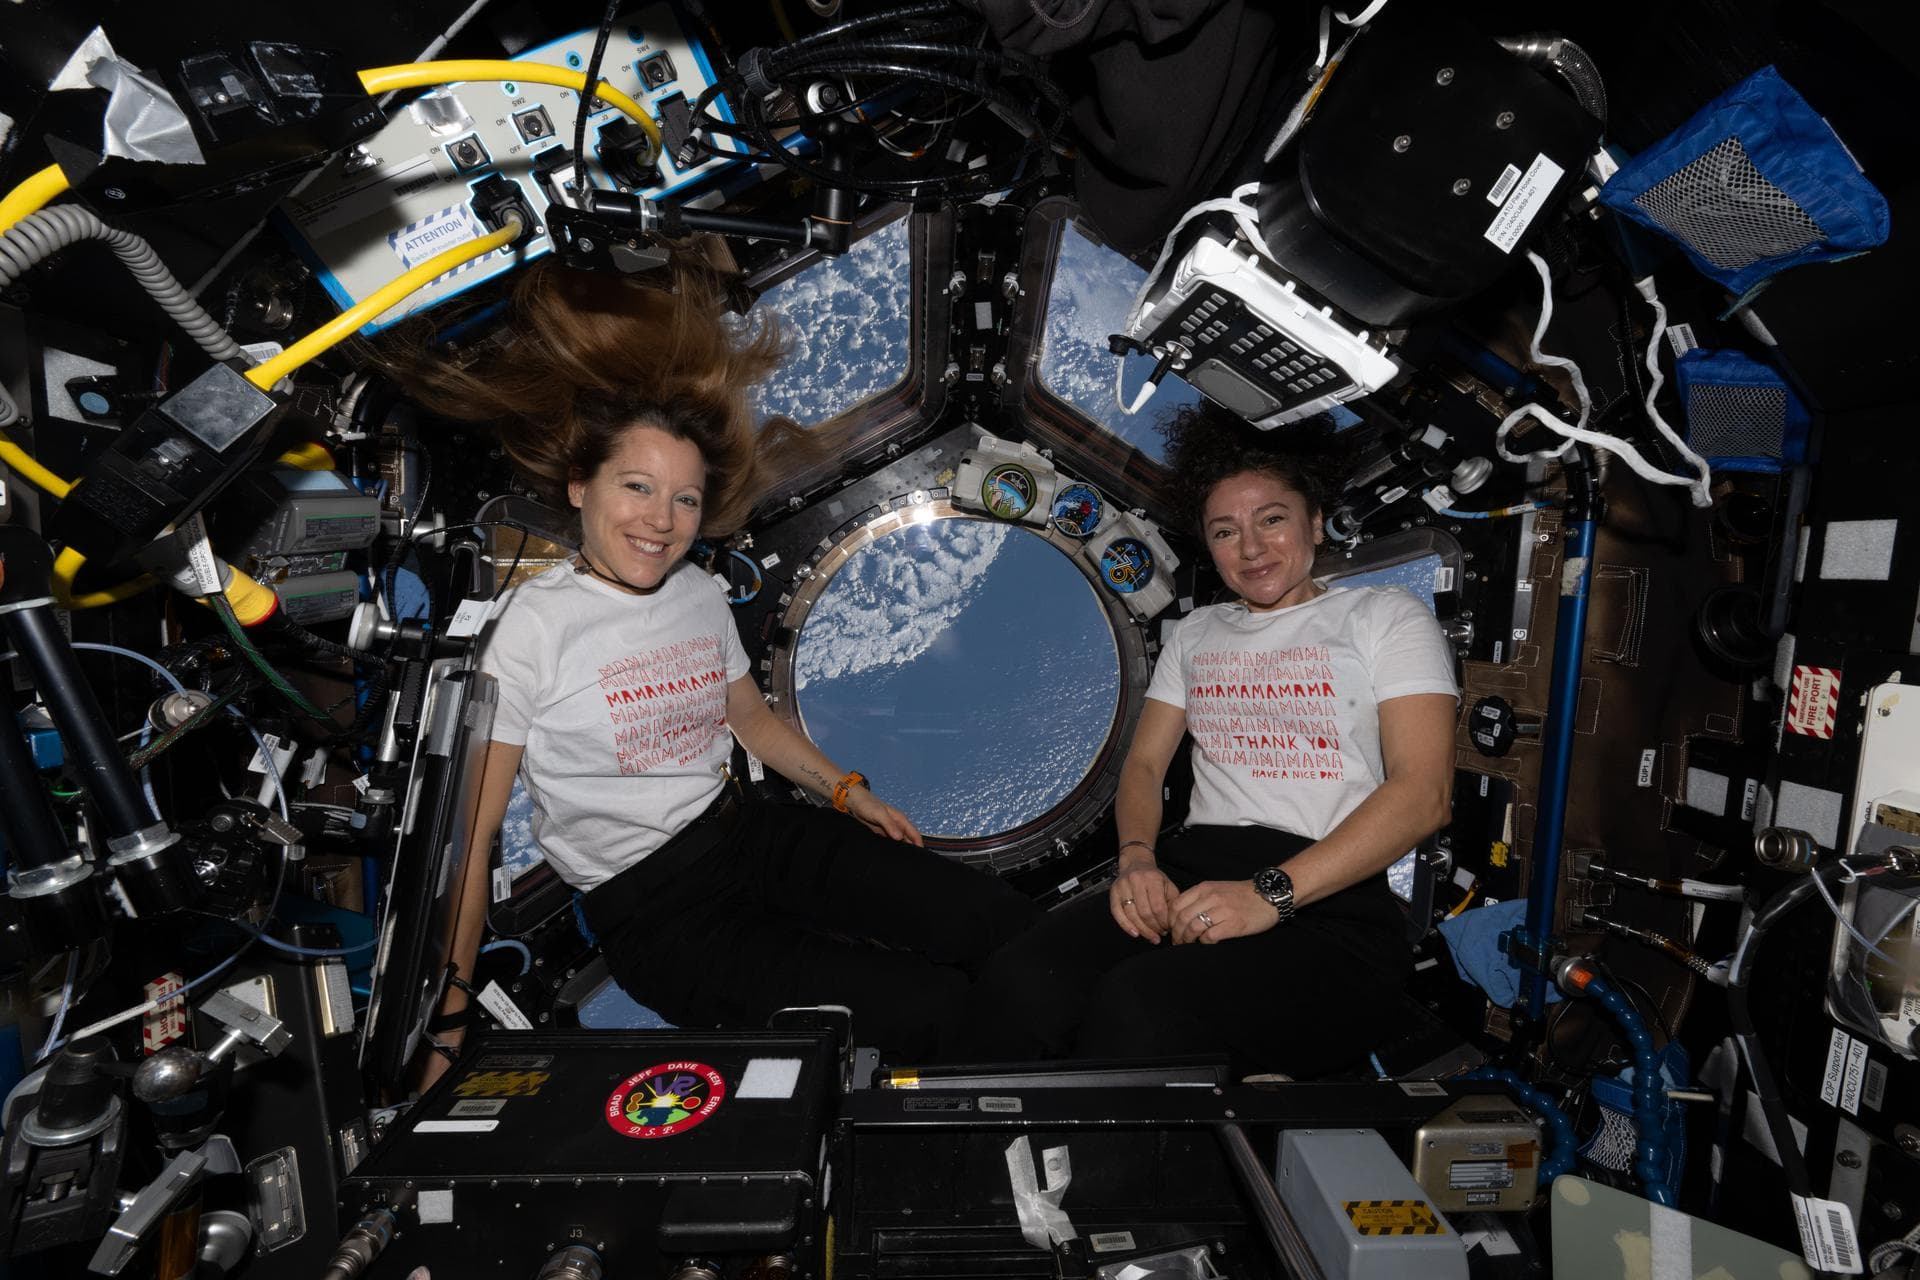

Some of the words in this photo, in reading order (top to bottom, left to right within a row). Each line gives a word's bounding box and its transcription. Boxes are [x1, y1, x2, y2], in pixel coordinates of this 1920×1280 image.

[621, 64, 631, 72] ON
[512, 97, 526, 107] SW2
[496, 118, 506, 126] ON
[430, 146, 440, 155] ON
[509, 145, 520, 154] OFF
[405, 219, 463, 251] ATTENTION
[1513, 630, 1526, 640] G
[1192, 646, 1331, 666] MAMAMAMAMAMA
[1189, 664, 1334, 682] MAMAMAMAMAMA
[1189, 682, 1336, 699] MAMAMAMAMAMA
[1811, 678, 1821, 703] PORT
[1188, 700, 1337, 717] MAMAMAMAMAMA
[1799, 689, 1809, 723] EMERGENCY
[1807, 706, 1817, 726] FIRE
[1189, 717, 1338, 735] MAMAMAMAMAMA
[1233, 735, 1299, 750] THANK
[1305, 735, 1339, 750] YOU
[678, 753, 697, 766] HAVE
[1252, 769, 1278, 778] HAVE
[1281, 771, 1289, 779] A
[1293, 770, 1316, 779] NICE
[1319, 771, 1344, 781] DAY!
[160, 1010, 168, 1036] PORT
[1834, 1032, 1845, 1050] Brkt
[1828, 1049, 1842, 1082] Support
[628, 1069, 653, 1086] JEFF
[706, 1071, 722, 1086] KEN
[1824, 1081, 1836, 1102] UOP
[609, 1094, 623, 1117] BRAD
[700, 1096, 720, 1116] ERIN
[1489, 1217, 1505, 1236] Cupola
[1504, 1204, 1514, 1216] ATU
[1520, 1178, 1532, 1193] Hose
[1529, 1161, 1543, 1178] Cover
[569, 1229, 583, 1238] J3
